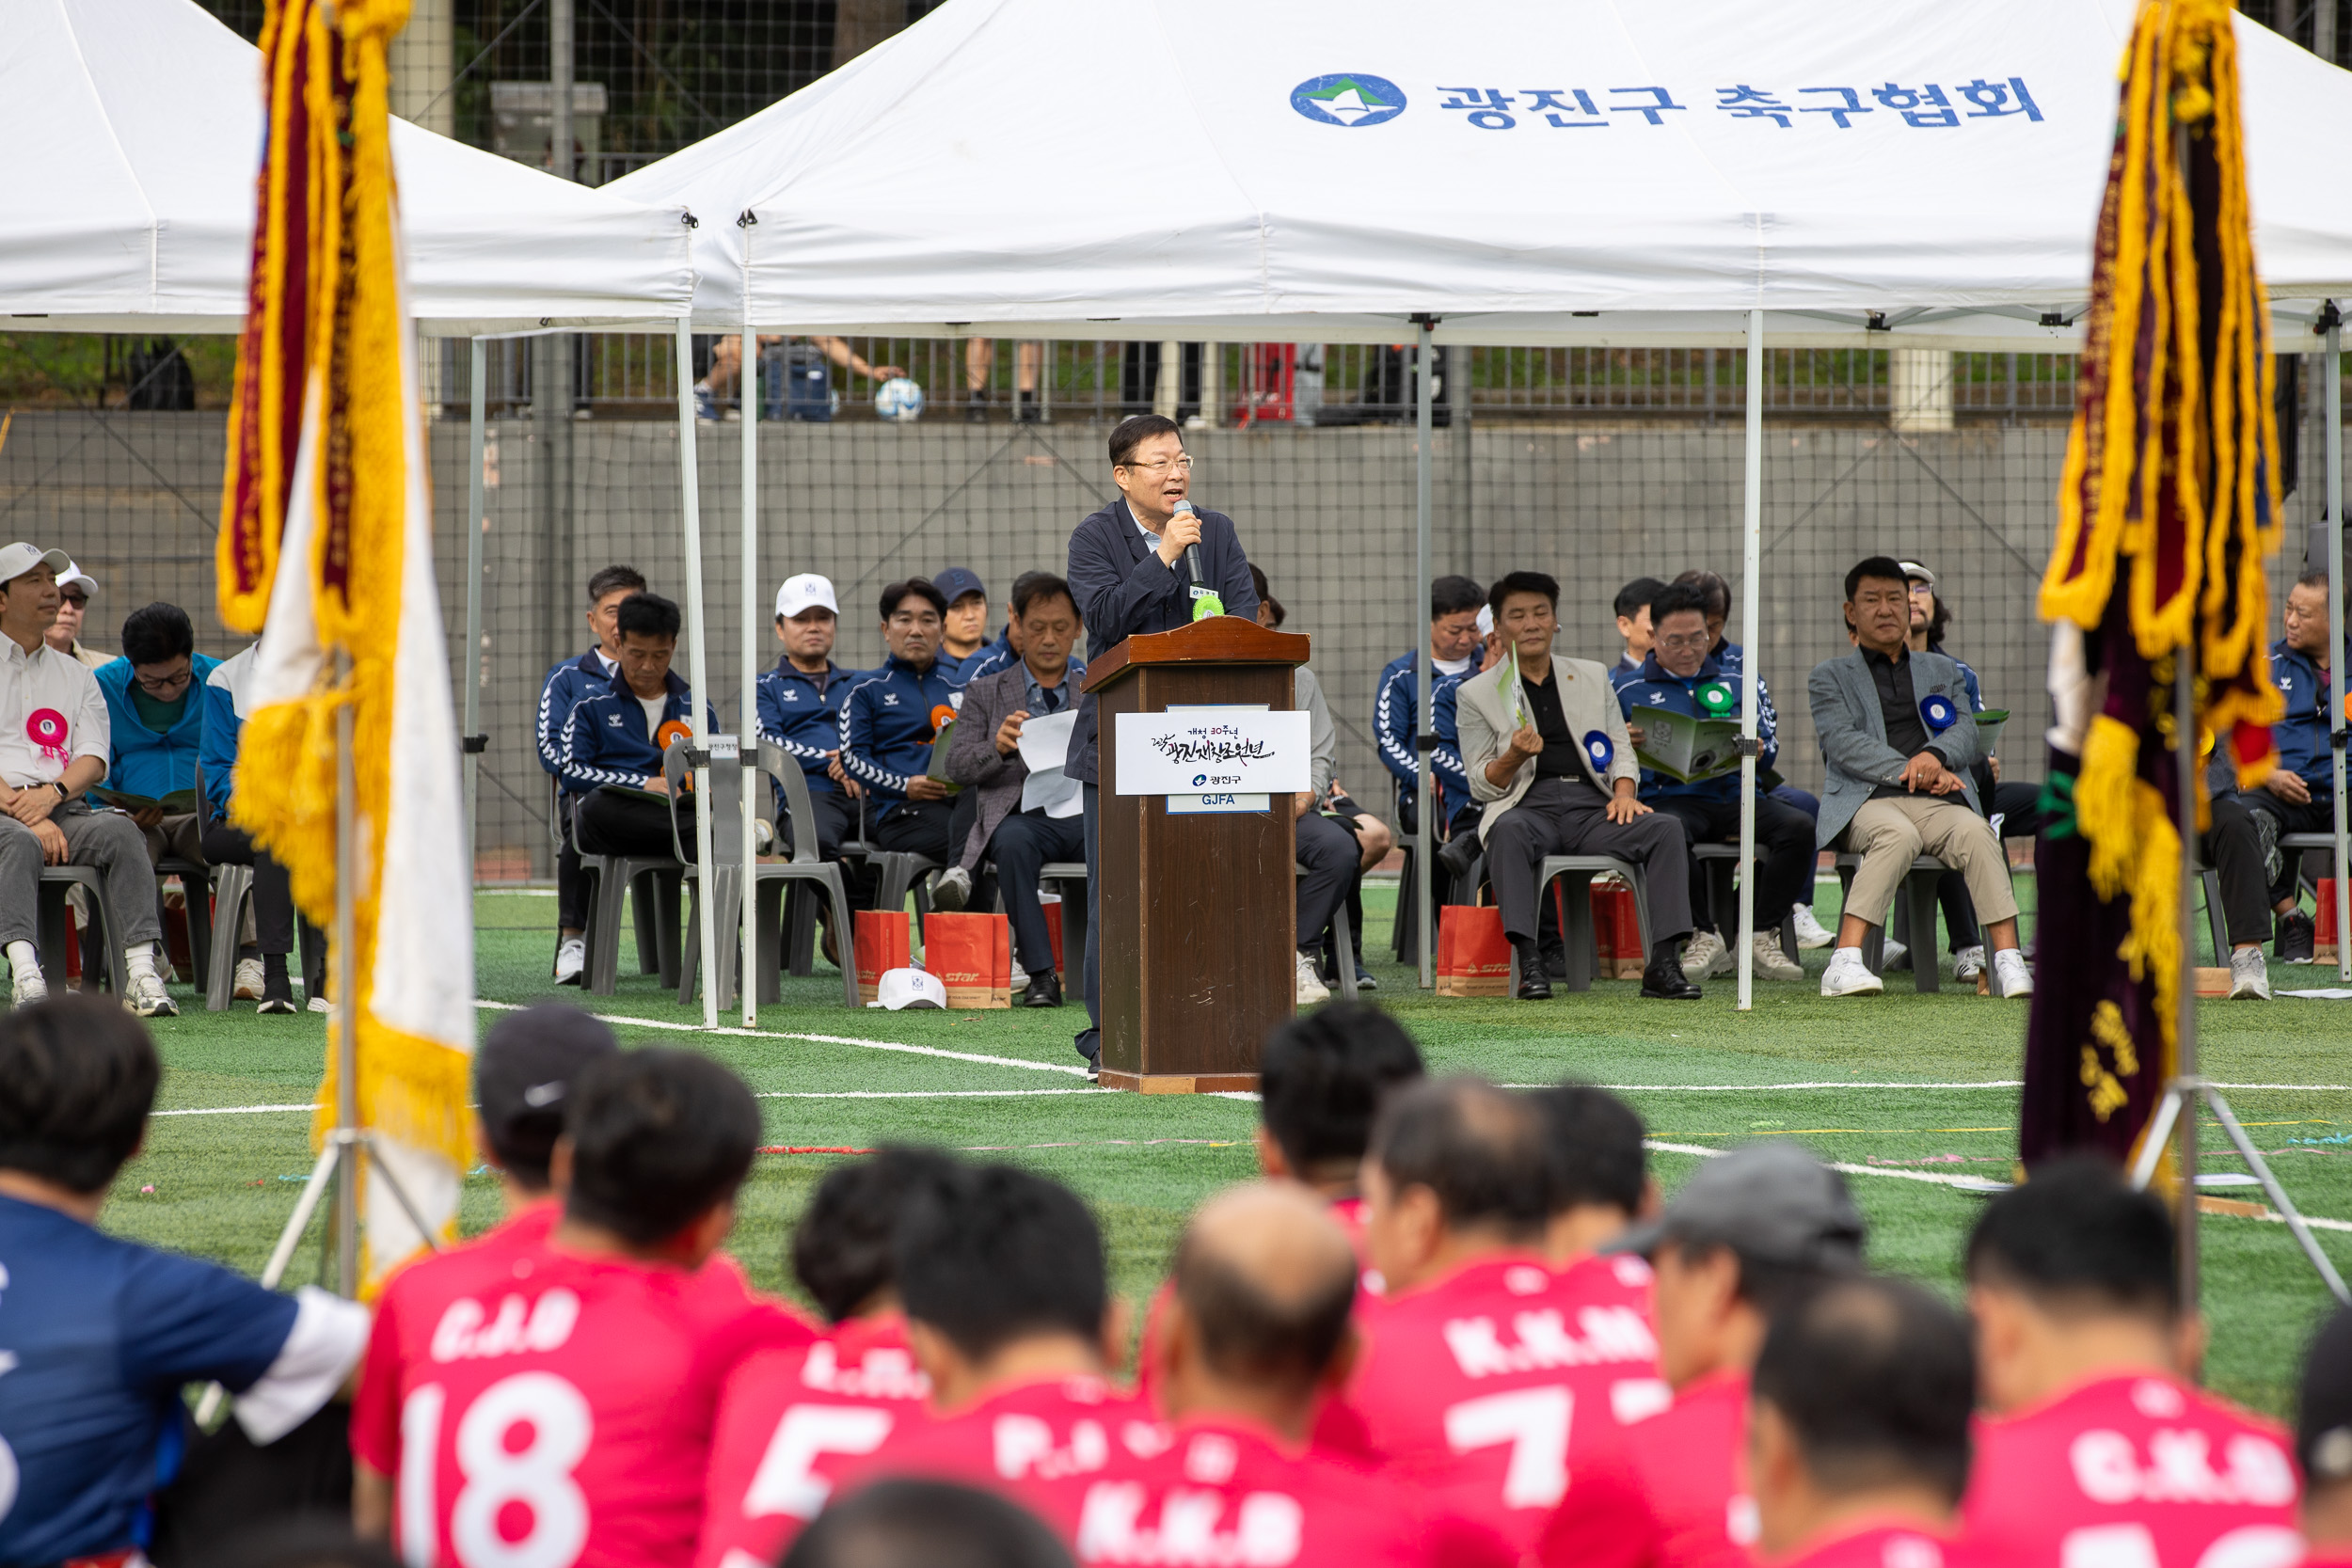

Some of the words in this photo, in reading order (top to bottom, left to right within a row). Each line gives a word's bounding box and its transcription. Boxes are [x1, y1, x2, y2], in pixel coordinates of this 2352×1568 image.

[1436, 85, 1688, 131] 광진구
[1714, 76, 2046, 130] 축구협회
[1187, 727, 1207, 739] 개청
[1210, 724, 1239, 739] 30주년
[1209, 775, 1242, 785] 광진구
[1201, 794, 1235, 805] GJFA
[945, 972, 979, 983] star
[400, 1370, 594, 1568] 18
